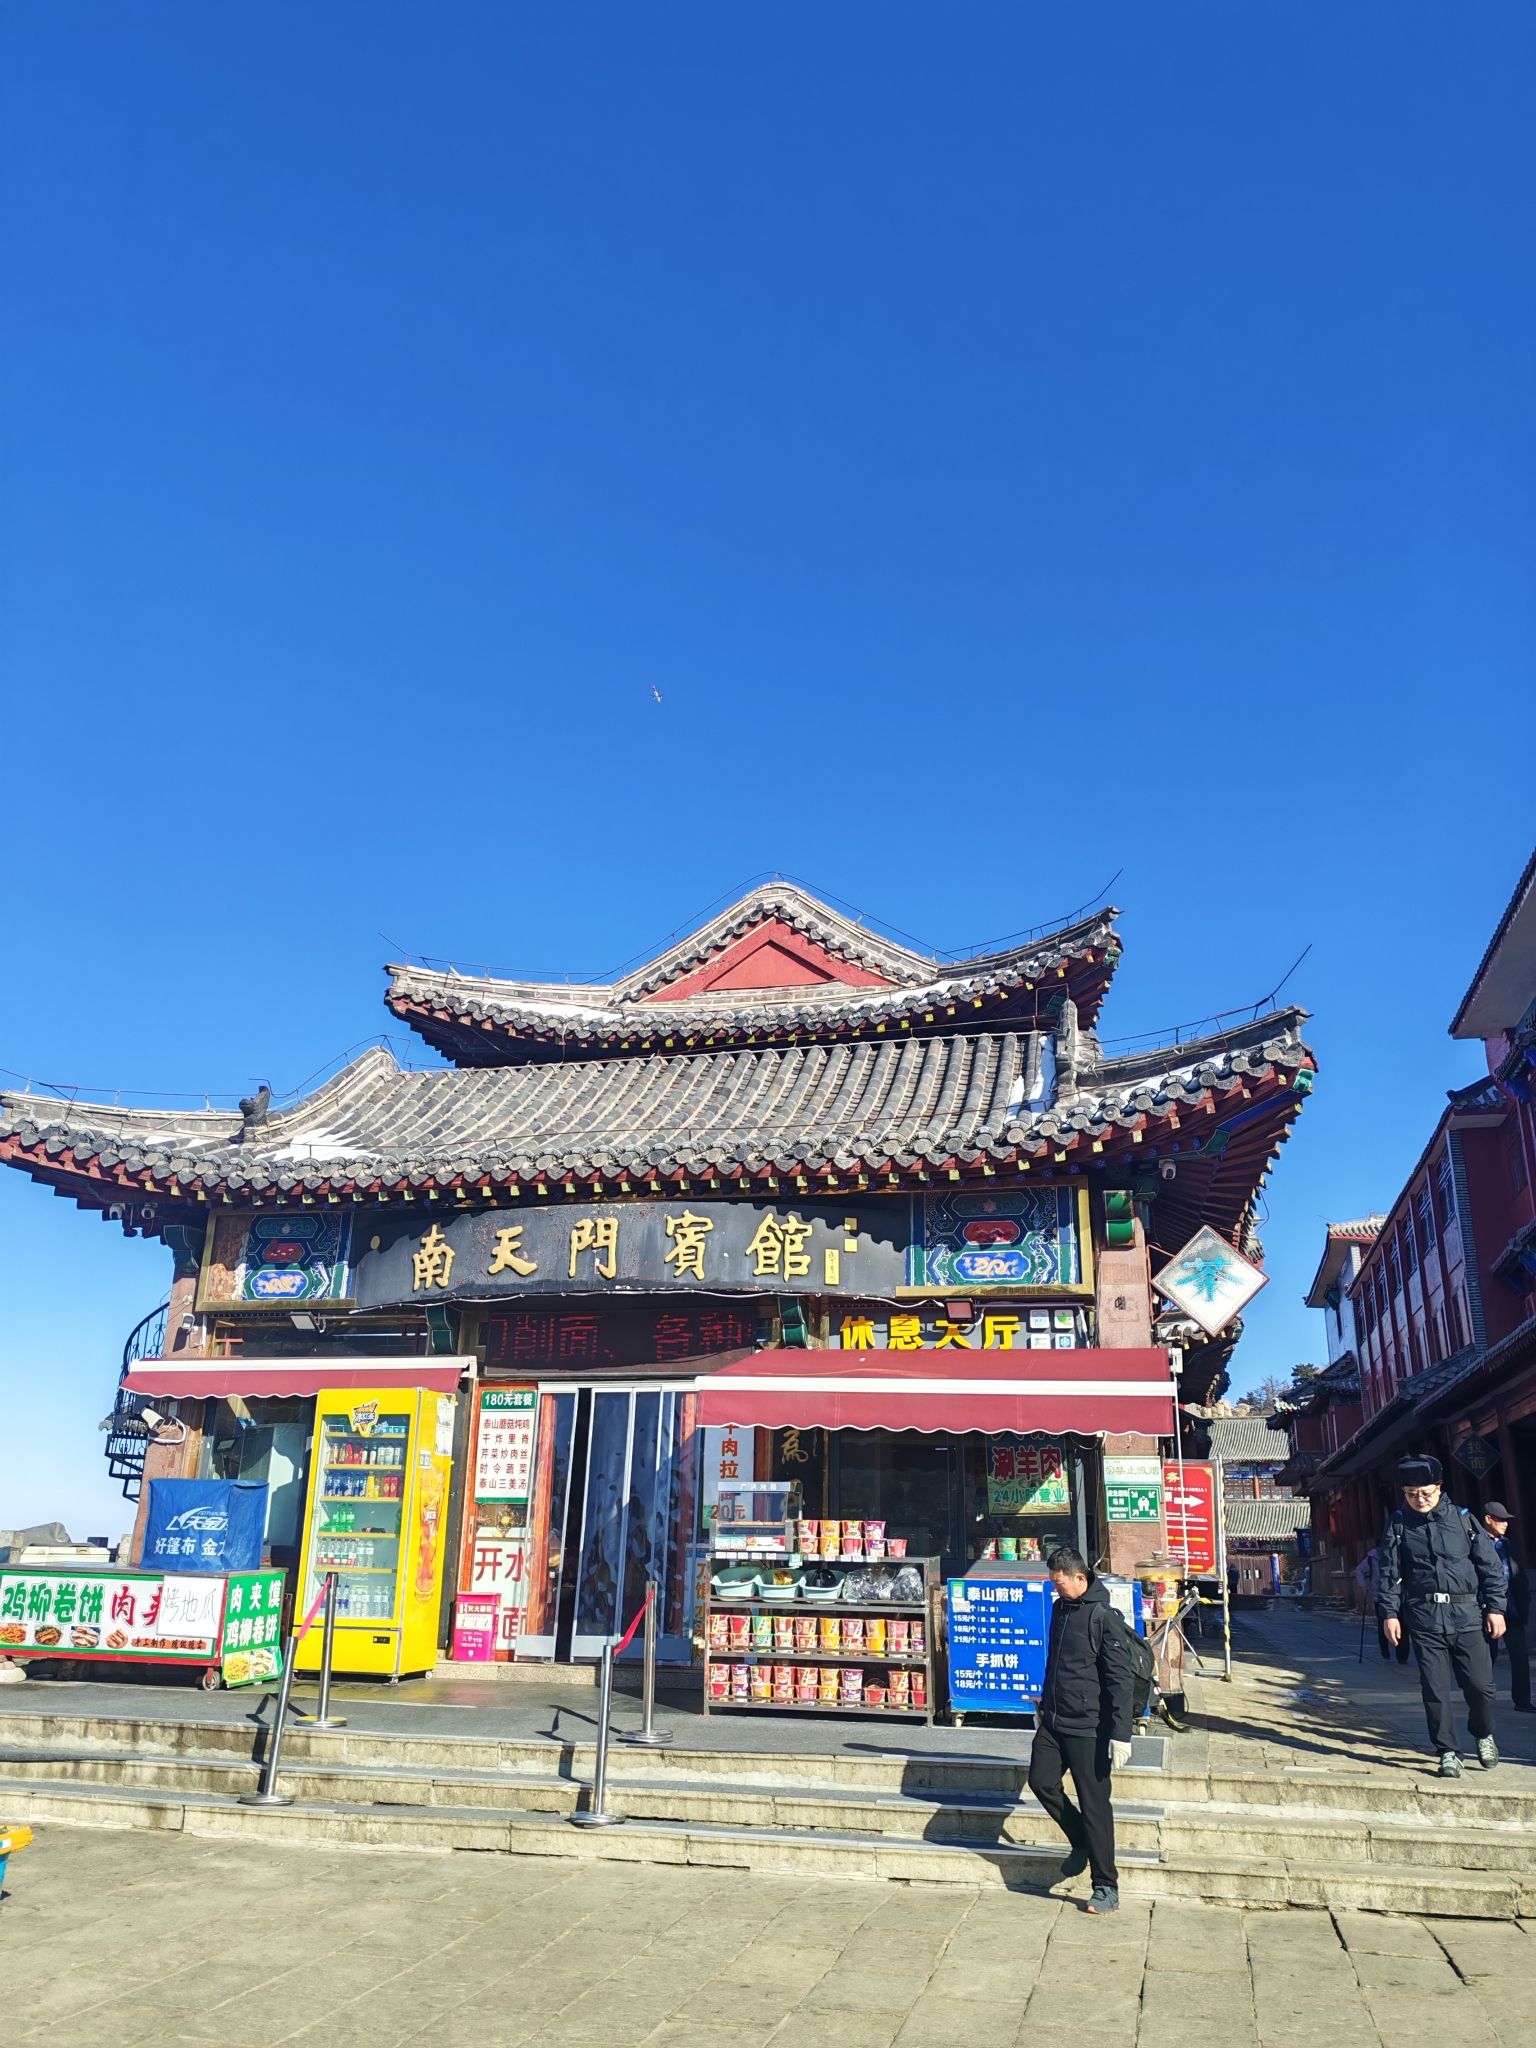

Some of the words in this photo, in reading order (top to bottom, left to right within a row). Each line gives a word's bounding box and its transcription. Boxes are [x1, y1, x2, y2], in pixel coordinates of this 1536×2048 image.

[412, 1209, 814, 1292] 南天門賓館
[840, 1313, 1021, 1350] 休息大厅
[484, 1392, 534, 1407] 180元套餐
[480, 1448, 529, 1460] 芹菜炒肉丝
[992, 1446, 1062, 1480] 涮羊肉
[479, 1463, 528, 1475] 时令蔬菜
[993, 1487, 1067, 1503] 24小时营业
[1, 1581, 105, 1625] 鸡柳卷饼
[229, 1579, 282, 1614] 肉夹馍
[967, 1587, 1024, 1603] 泰山煎饼
[225, 1614, 278, 1649] 鸡柳卷饼
[976, 1653, 1019, 1669] 手抓饼
